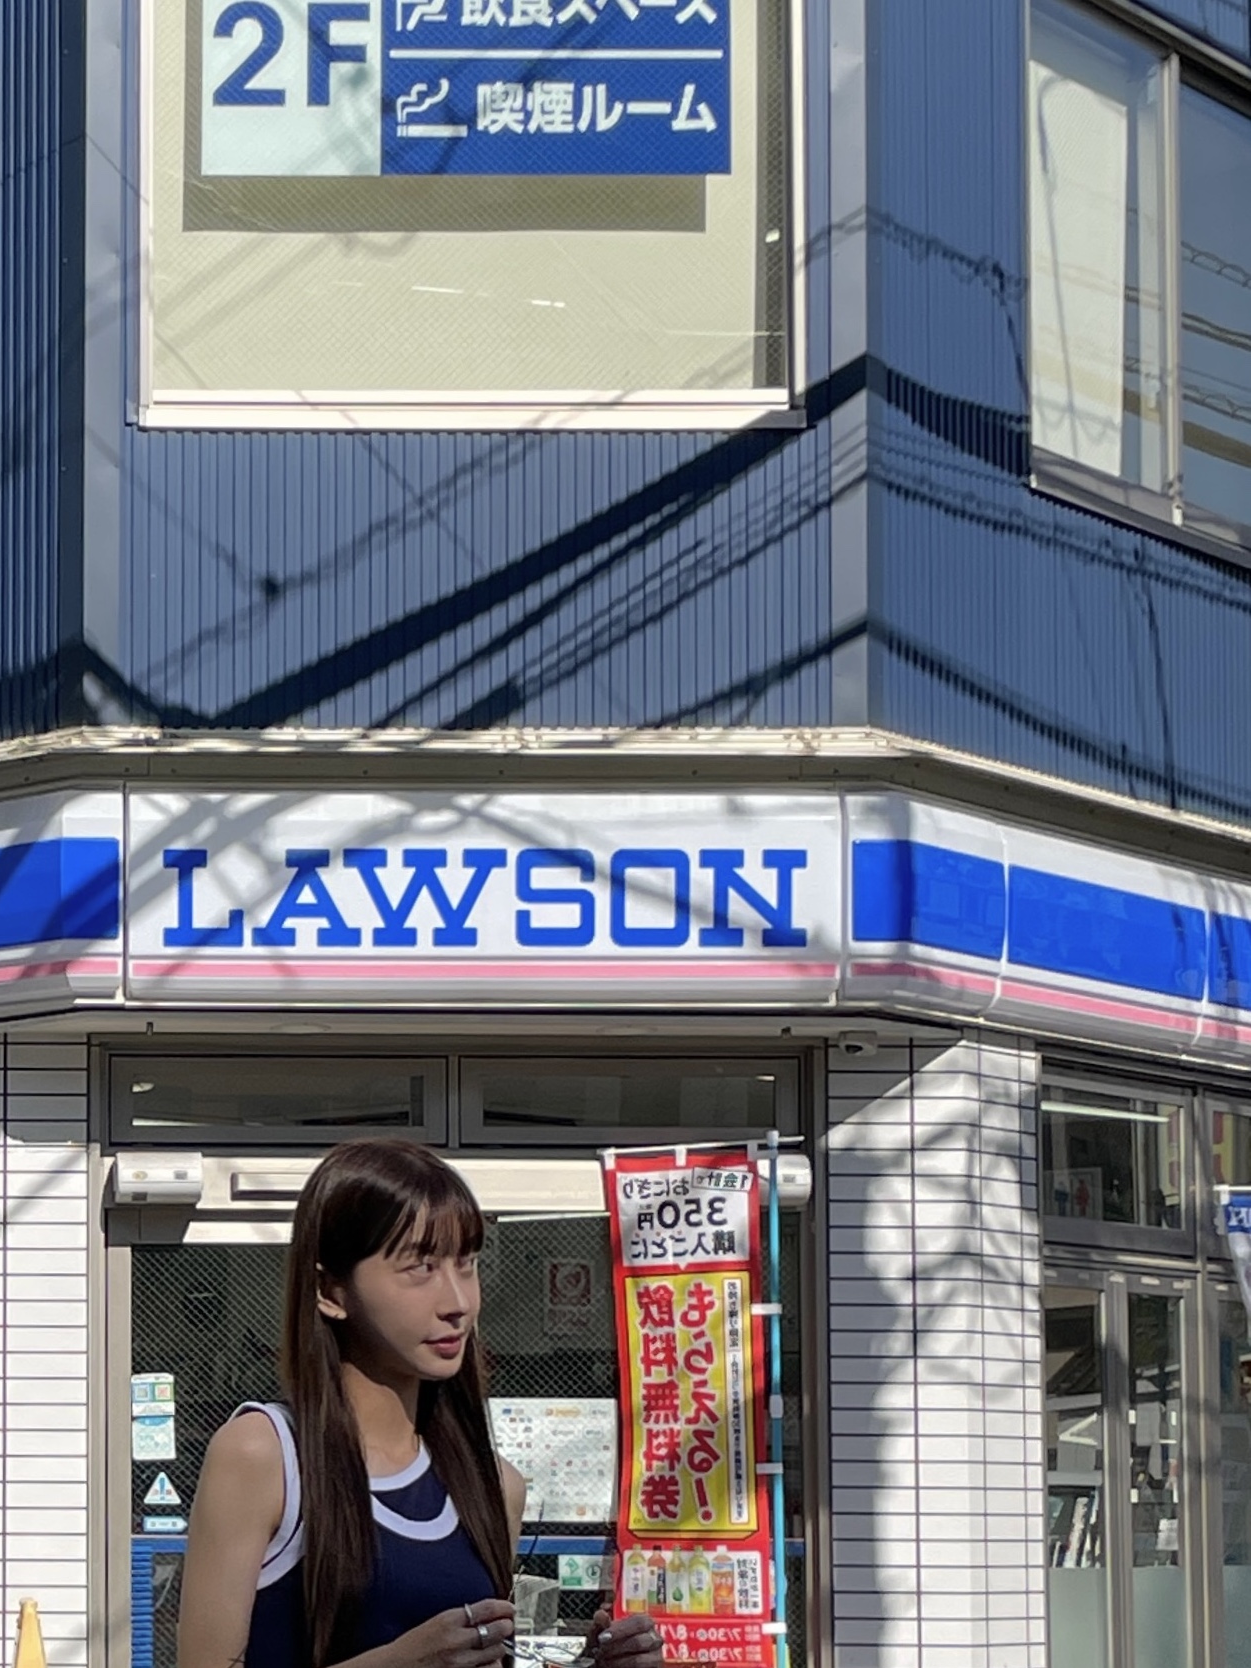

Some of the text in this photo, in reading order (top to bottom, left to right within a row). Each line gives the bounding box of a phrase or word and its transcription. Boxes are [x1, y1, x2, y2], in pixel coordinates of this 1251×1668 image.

[212, 1, 370, 107] 2F
[476, 81, 717, 135] 喫煙ルーム
[162, 848, 808, 949] LAWSON
